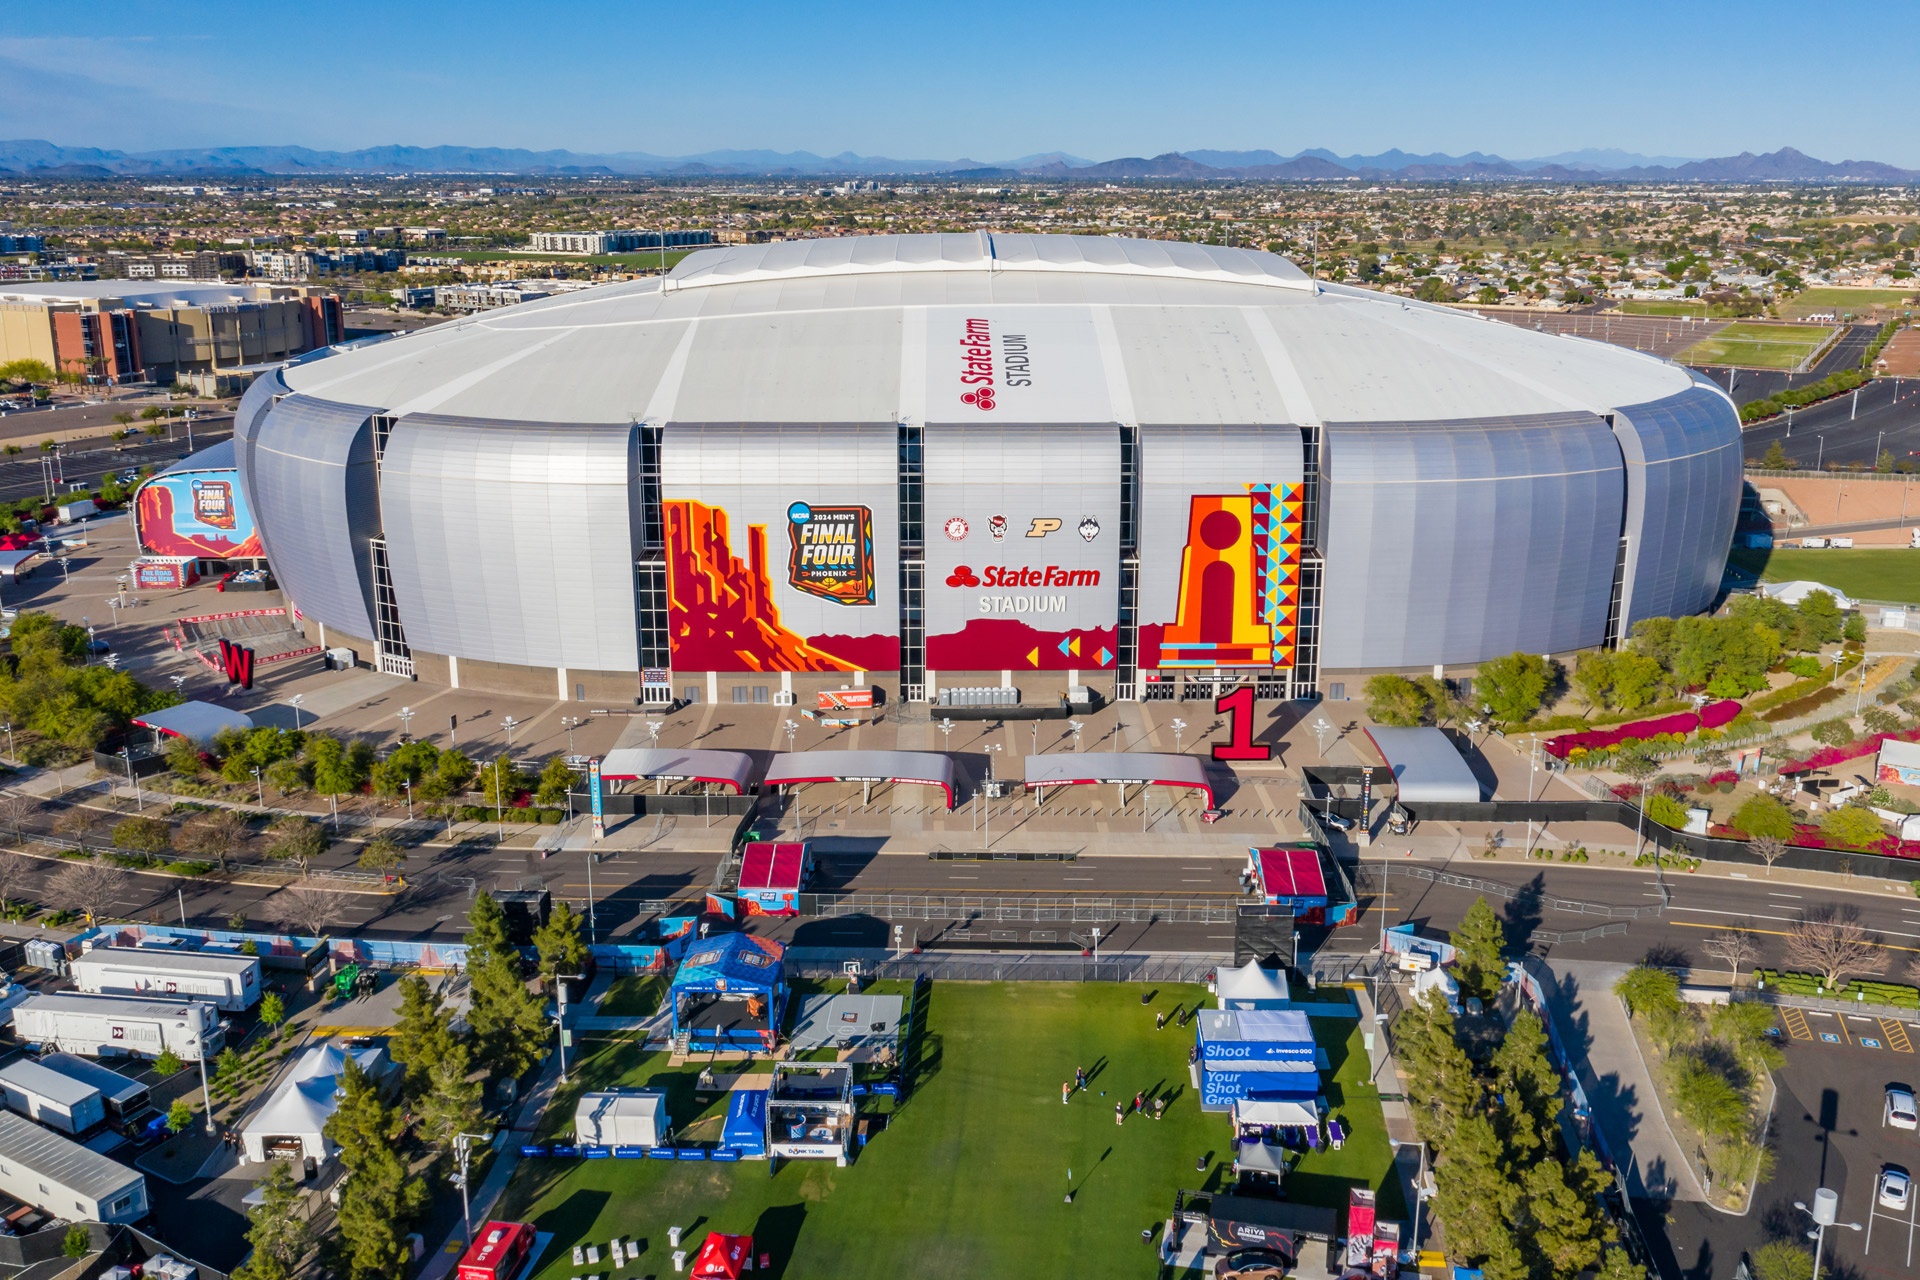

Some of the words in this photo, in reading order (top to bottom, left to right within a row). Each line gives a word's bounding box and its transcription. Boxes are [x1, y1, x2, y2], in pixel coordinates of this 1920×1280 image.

[960, 318, 994, 386] StateFarm
[1002, 334, 1032, 387] STADIUM
[198, 490, 225, 500] FINAL
[199, 500, 226, 510] FOUR
[801, 523, 856, 545] FINAL
[1025, 517, 1063, 538] P
[801, 545, 856, 565] FOUR
[982, 565, 1100, 587] StateFarm
[979, 596, 1067, 613] STADIUM
[219, 637, 255, 690] W
[1211, 684, 1271, 761] 1
[1205, 1045, 1251, 1057] Shoot
[1208, 1072, 1241, 1082] Your
[1205, 1082, 1241, 1093] Shot
[1238, 1226, 1265, 1237] ARIYA
[715, 1265, 725, 1273] LG
